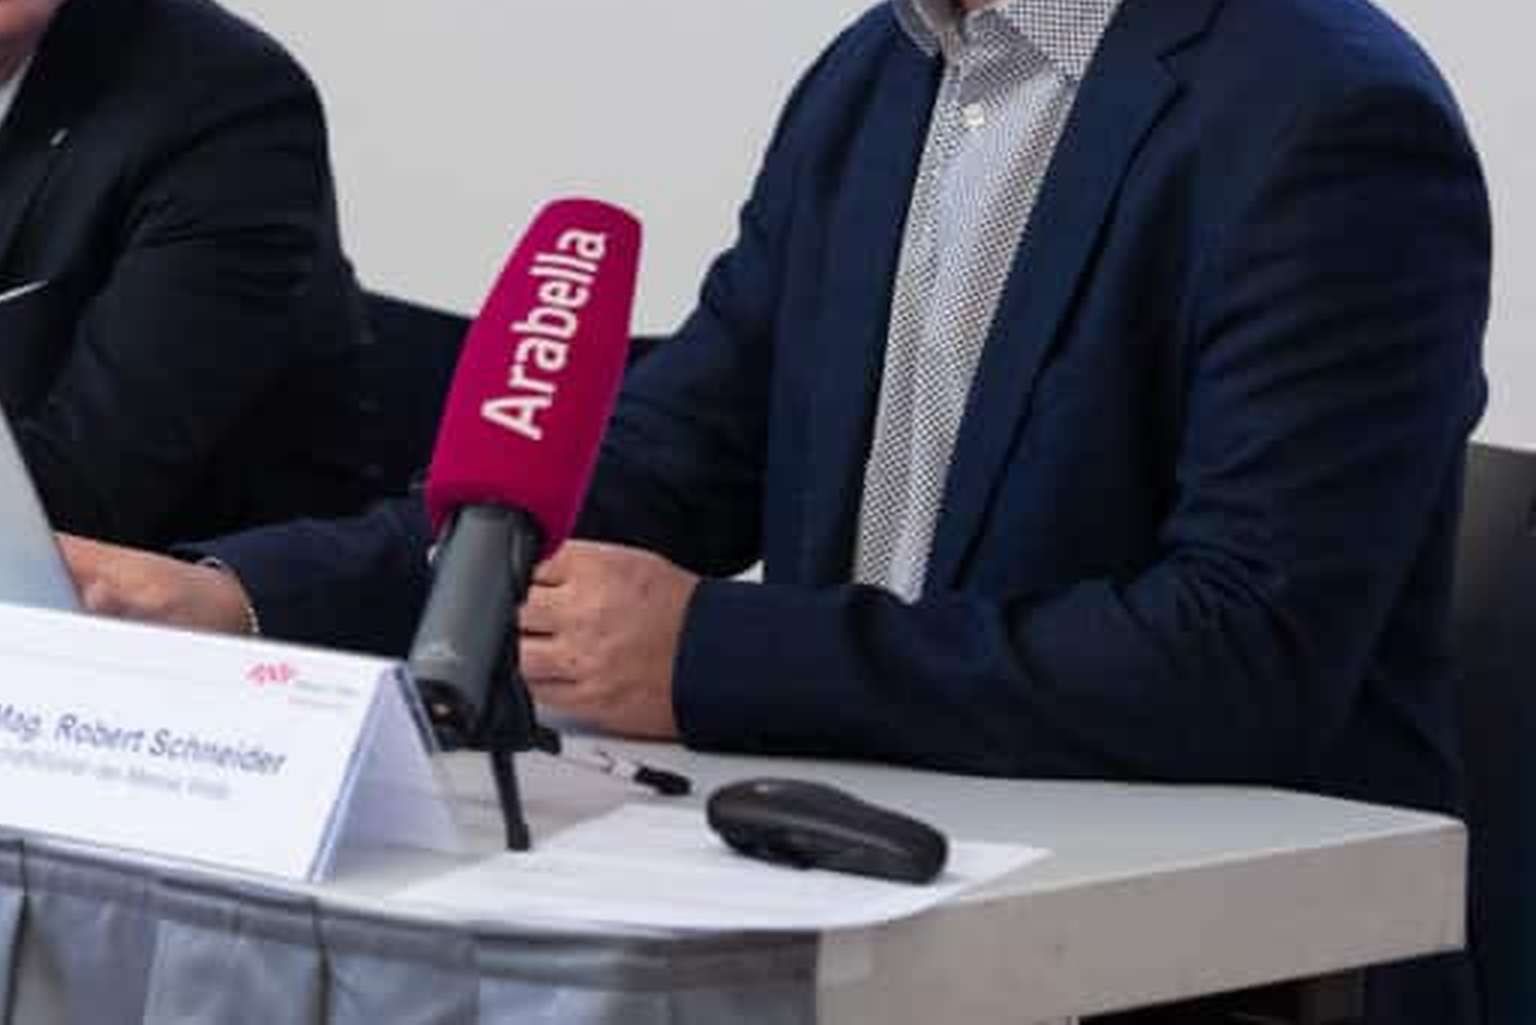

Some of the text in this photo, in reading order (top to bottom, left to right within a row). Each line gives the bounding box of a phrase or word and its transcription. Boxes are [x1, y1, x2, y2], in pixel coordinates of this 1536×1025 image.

[479, 227, 608, 442] Arabella
[54, 714, 146, 754] Robert
[148, 728, 287, 775] Schneider
